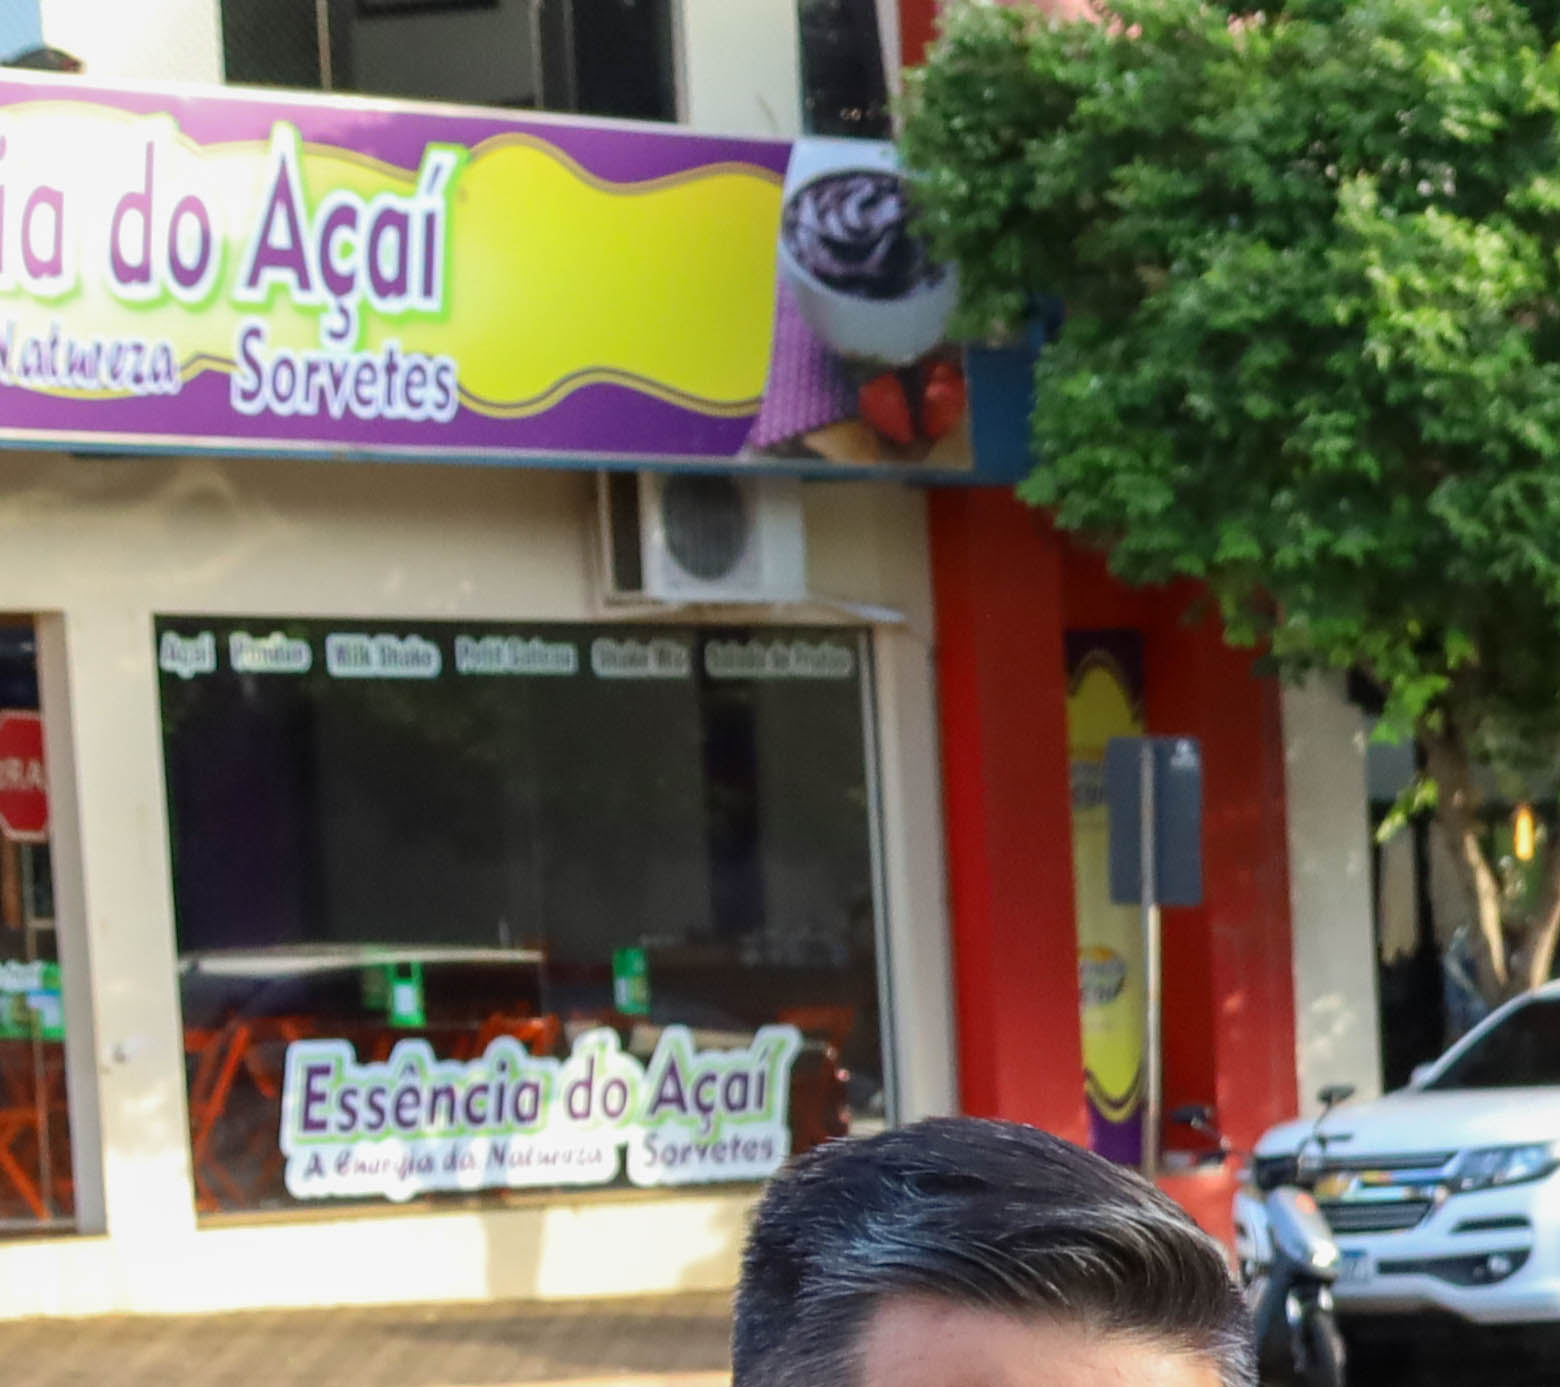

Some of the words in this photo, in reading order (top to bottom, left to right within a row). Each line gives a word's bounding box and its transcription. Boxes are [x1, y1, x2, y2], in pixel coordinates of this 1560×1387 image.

[110, 141, 211, 288] do
[246, 154, 441, 339] Açaí
[239, 327, 453, 411] Sorvetes
[301, 1060, 542, 1132] Essência
[567, 1055, 629, 1120] do
[648, 1047, 776, 1134] Açaí
[304, 1153, 326, 1179] A
[643, 1132, 774, 1169] Sorvetes
